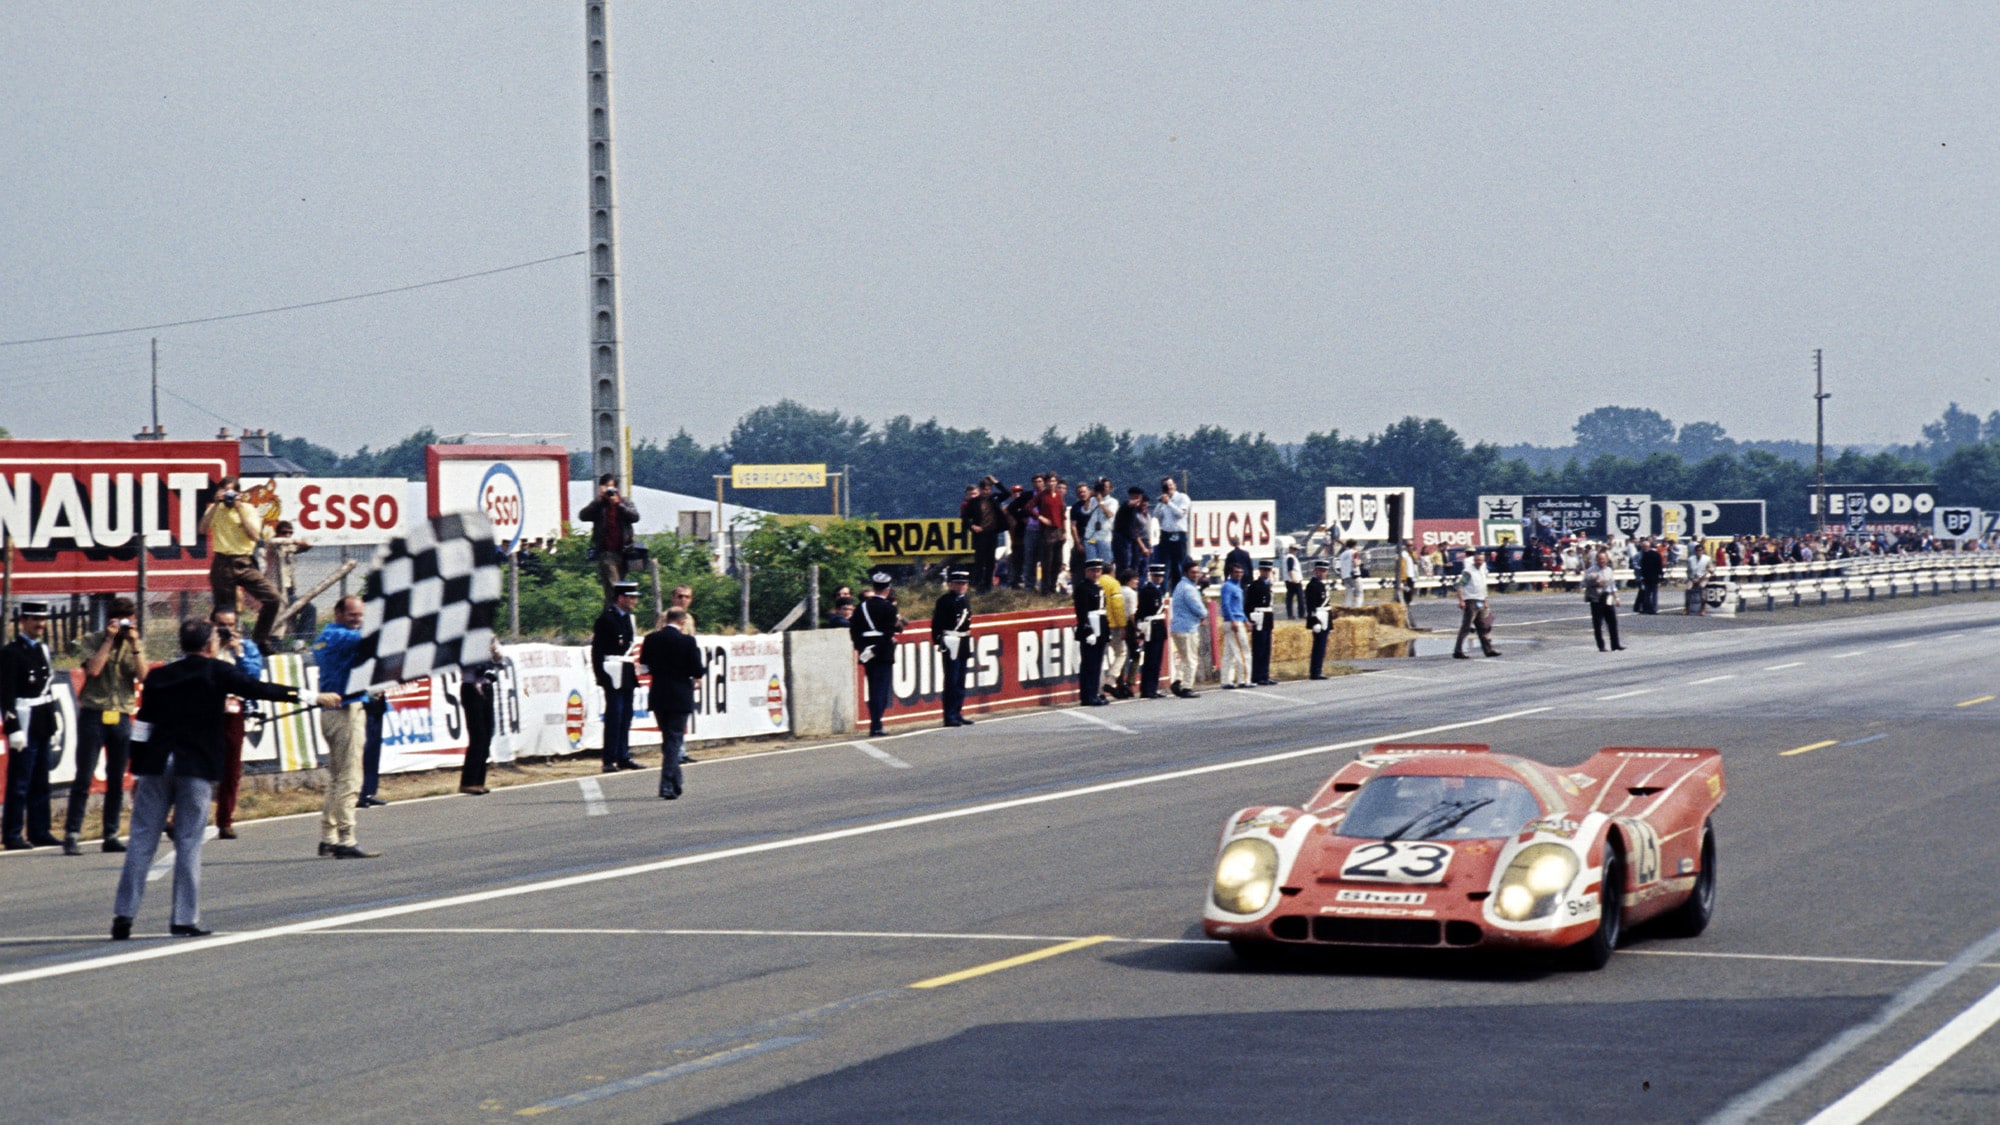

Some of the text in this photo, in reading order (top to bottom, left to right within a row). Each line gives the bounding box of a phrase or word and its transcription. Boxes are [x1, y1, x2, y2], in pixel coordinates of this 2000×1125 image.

[0, 472, 209, 548] NAULT
[1339, 499, 1354, 521] BP
[1361, 499, 1377, 521] BP
[1656, 503, 1720, 538] BP
[1193, 511, 1271, 548] LUCAS
[1620, 516, 1639, 530] BP
[1947, 514, 1970, 529] BP
[865, 522, 974, 556] ARDAH
[1422, 531, 1475, 548] super
[1343, 842, 1458, 877] 23
[1342, 890, 1423, 903] Shell
[1319, 905, 1436, 918] PORSCHE
